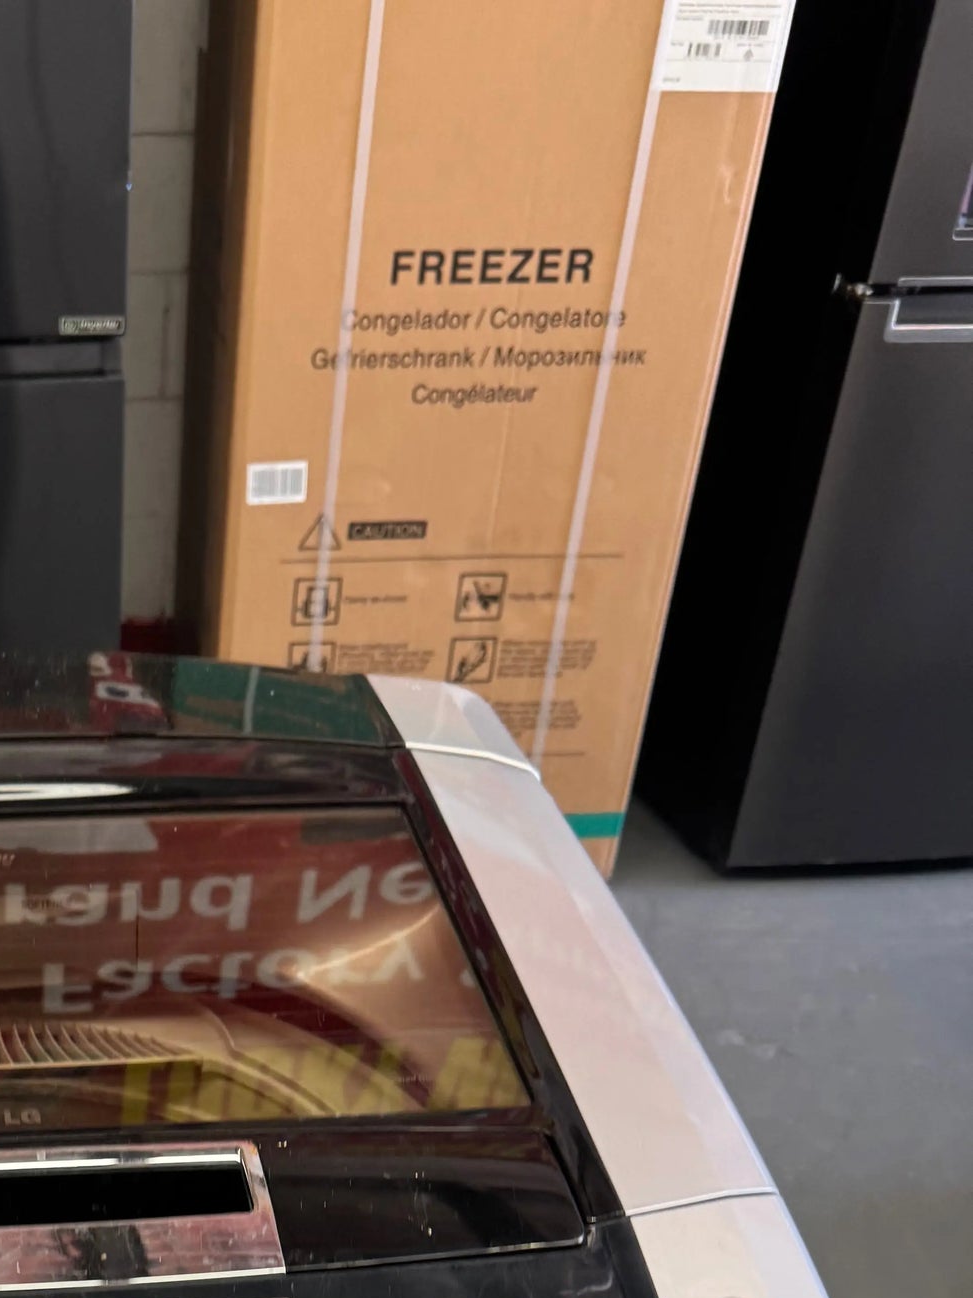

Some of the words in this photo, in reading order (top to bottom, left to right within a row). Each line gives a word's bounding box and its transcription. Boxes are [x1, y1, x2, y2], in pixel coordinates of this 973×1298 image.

[390, 248, 594, 286] FREEZER
[411, 382, 538, 408] Congélateur
[350, 523, 424, 539] CAUTION
[3, 1108, 42, 1126] LG
